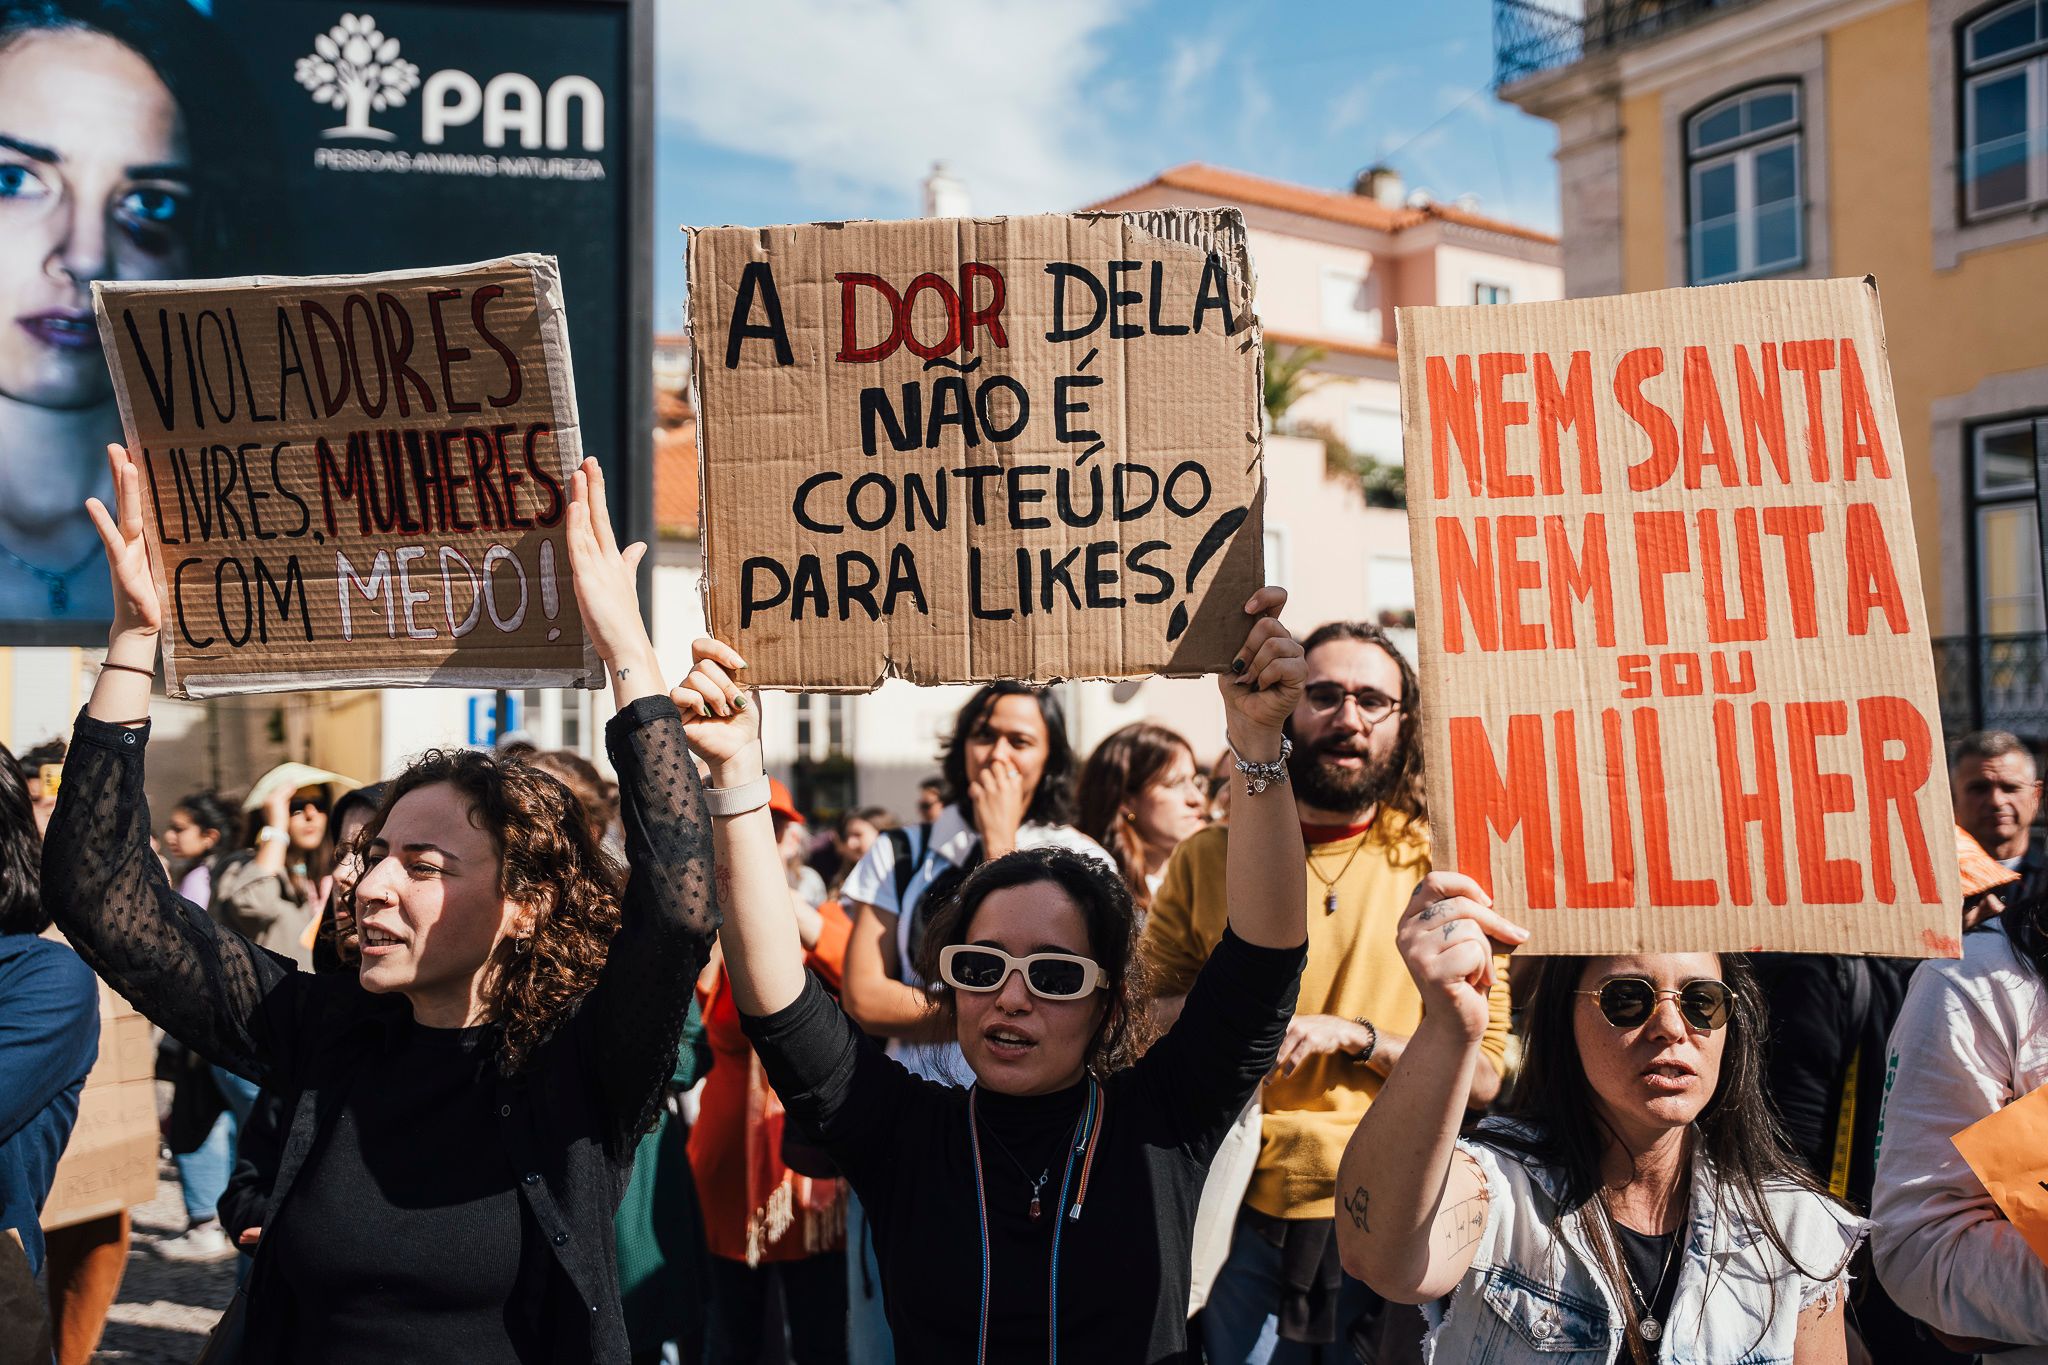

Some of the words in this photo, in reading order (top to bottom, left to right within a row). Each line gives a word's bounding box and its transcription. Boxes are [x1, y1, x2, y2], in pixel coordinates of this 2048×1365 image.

[422, 69, 604, 151] PAN
[124, 285, 522, 430] VIOLADORES
[725, 261, 794, 369] A
[834, 262, 1008, 363] DOR
[1044, 253, 1234, 342] DELA
[859, 356, 1030, 456] NÃO
[1055, 348, 1104, 443] É
[1425, 350, 1602, 499] NEM
[1613, 338, 1891, 493] SANTA
[143, 441, 325, 545] LIVRES,
[314, 422, 567, 537] MULHERES
[792, 441, 1212, 534] CONTEÚDO
[174, 555, 313, 648] COM
[336, 538, 562, 642] MEDO!
[741, 542, 929, 629] PARA
[969, 506, 1248, 642] LIKES!
[1435, 512, 1616, 654] NEM
[1634, 502, 1910, 645] PUTA
[1617, 651, 1756, 698] SOU
[1449, 696, 1942, 910] MULHER
